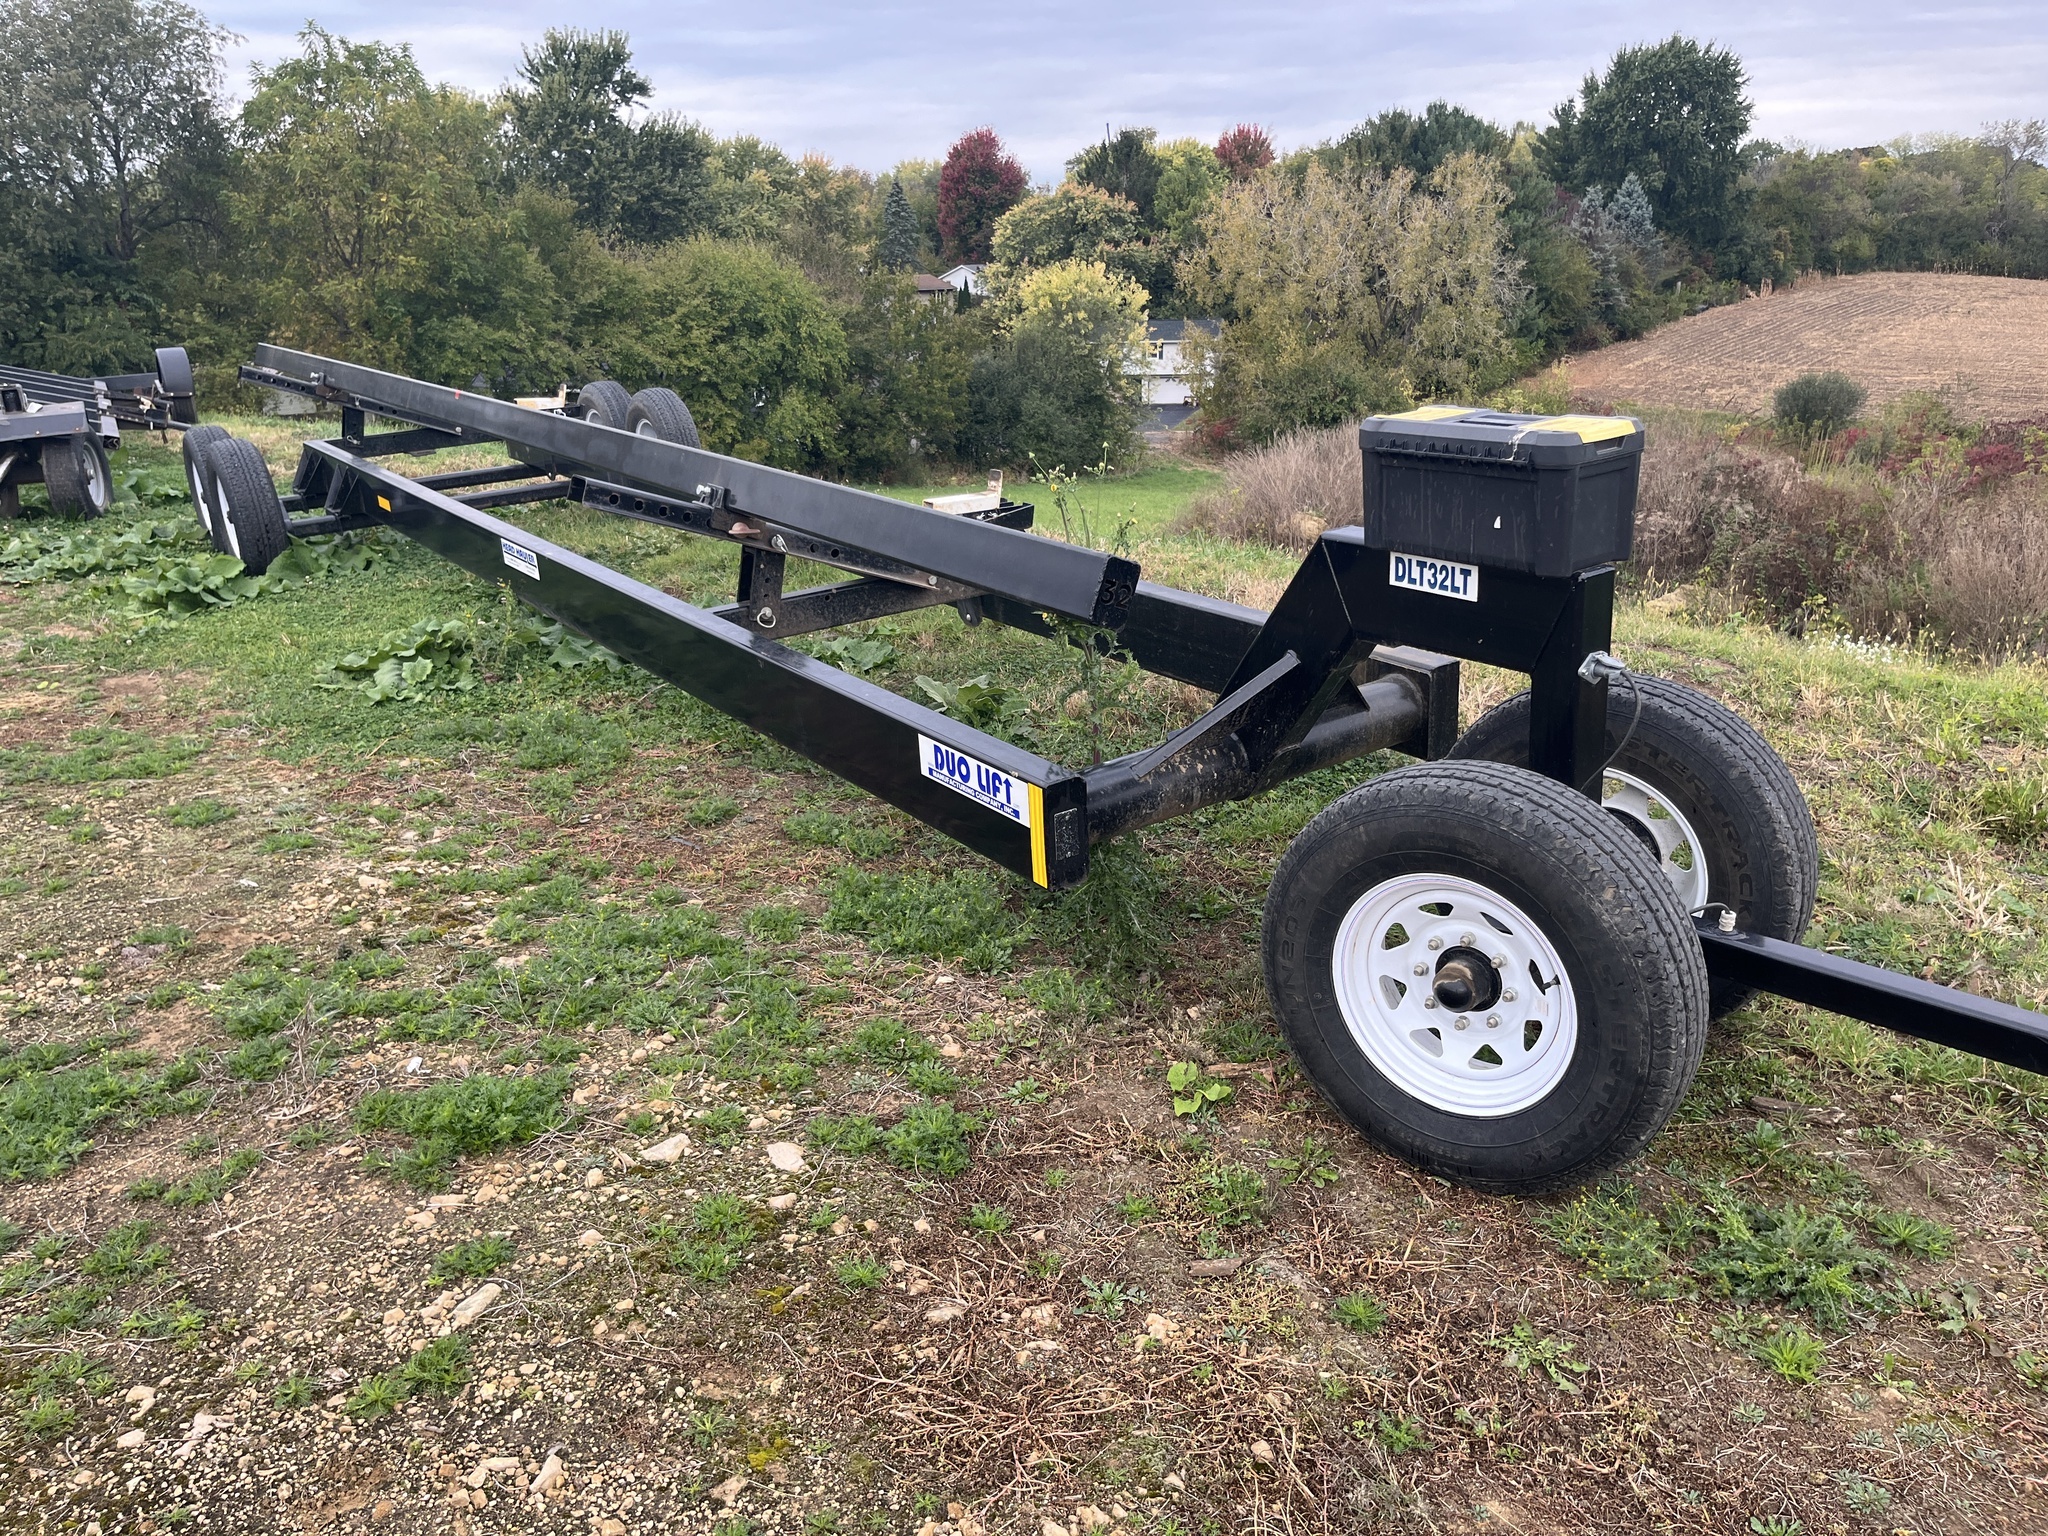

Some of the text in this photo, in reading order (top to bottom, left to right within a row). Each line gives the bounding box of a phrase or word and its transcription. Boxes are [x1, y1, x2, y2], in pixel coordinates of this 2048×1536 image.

[1395, 556, 1472, 596] DLT32LT
[1100, 578, 1133, 611] 32
[932, 770, 975, 798] MANUFACTURING
[933, 744, 1013, 805] DUO LIFT
